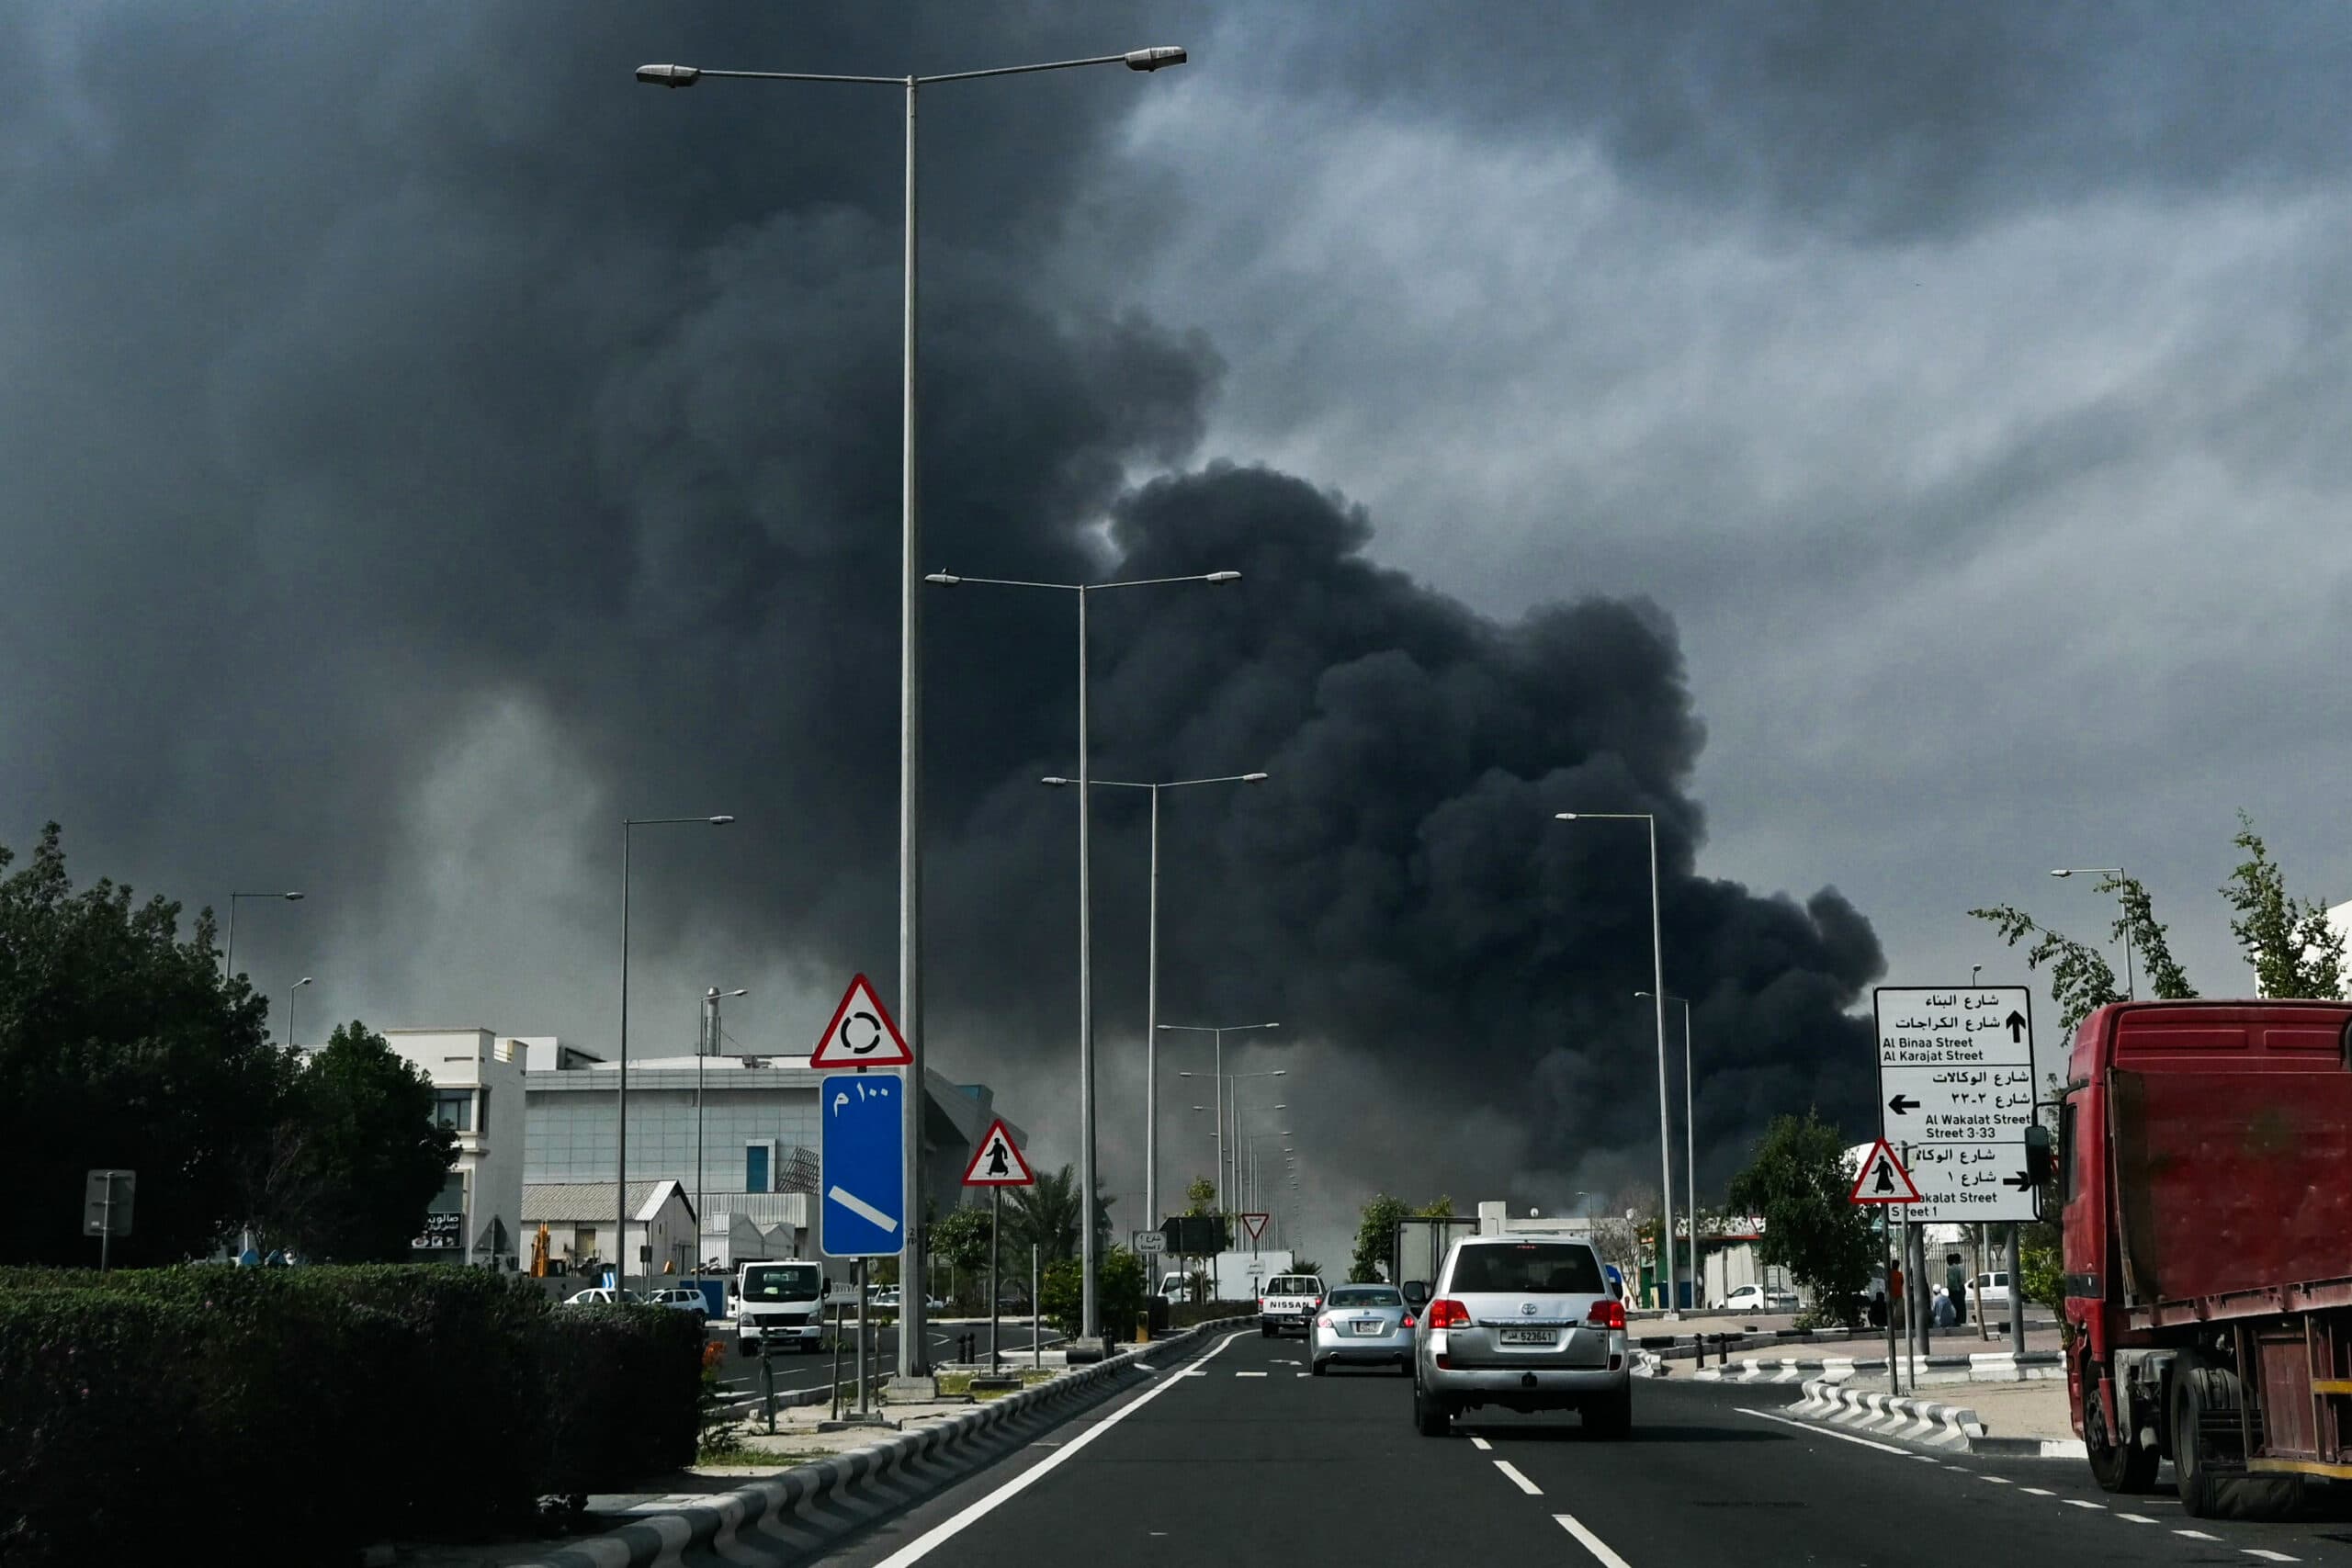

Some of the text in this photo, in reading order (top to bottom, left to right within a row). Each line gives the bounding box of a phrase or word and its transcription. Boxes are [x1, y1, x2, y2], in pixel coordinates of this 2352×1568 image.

[1926, 994, 1999, 1010] شارع البناء
[1895, 1016, 2001, 1032] شارع الكراجات
[1883, 1036, 1973, 1048] Al Binaa Street
[1883, 1050, 1984, 1063] Al Karajat Street
[1932, 1070, 2030, 1087] شارع الوكالات
[833, 1092, 849, 1117] م
[1995, 1092, 2030, 1109] شارع
[1925, 1113, 2030, 1125] Al Wakalat Street
[1926, 1126, 1996, 1139] Street 3-33
[1960, 1148, 1996, 1165] شارع
[1948, 1170, 1997, 1187] شارع ١
[1919, 1191, 1997, 1203] akalat Street
[1891, 1205, 1938, 1217] Sreet 1
